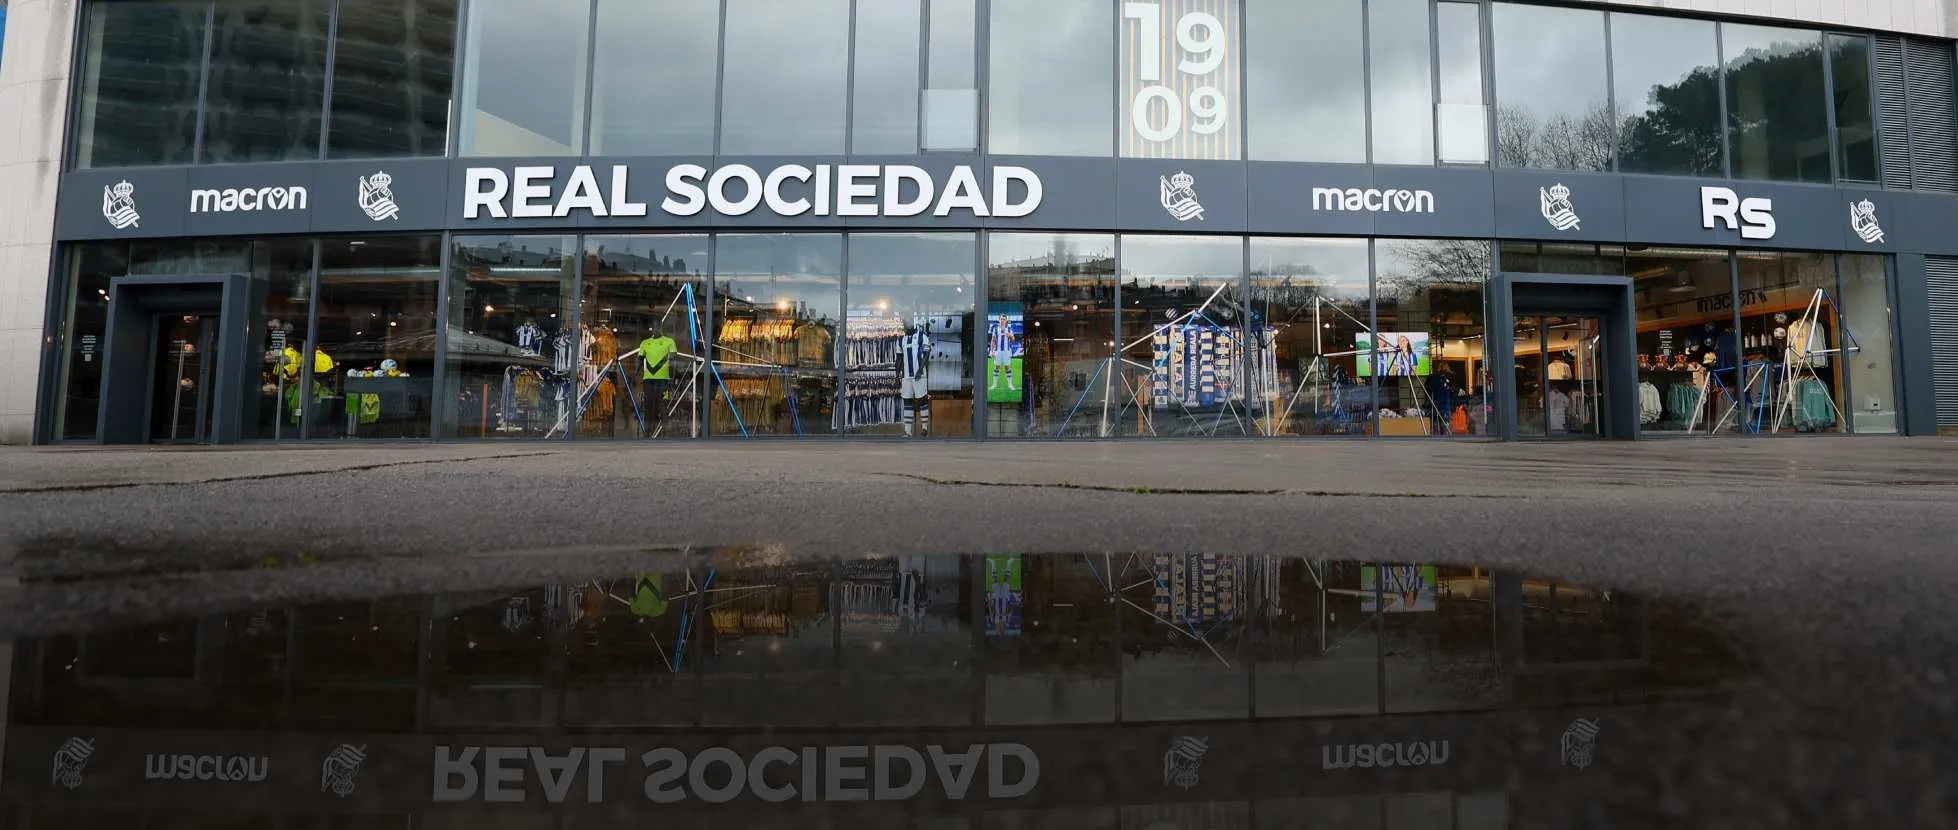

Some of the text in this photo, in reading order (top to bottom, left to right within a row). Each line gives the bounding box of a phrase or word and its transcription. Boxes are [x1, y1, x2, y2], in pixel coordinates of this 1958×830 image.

[1124, 2, 1226, 81] 19
[1132, 80, 1227, 142] 09
[190, 186, 308, 213] macron
[463, 163, 1043, 219] REAL SOCIEDAD
[1312, 186, 1435, 213] macron
